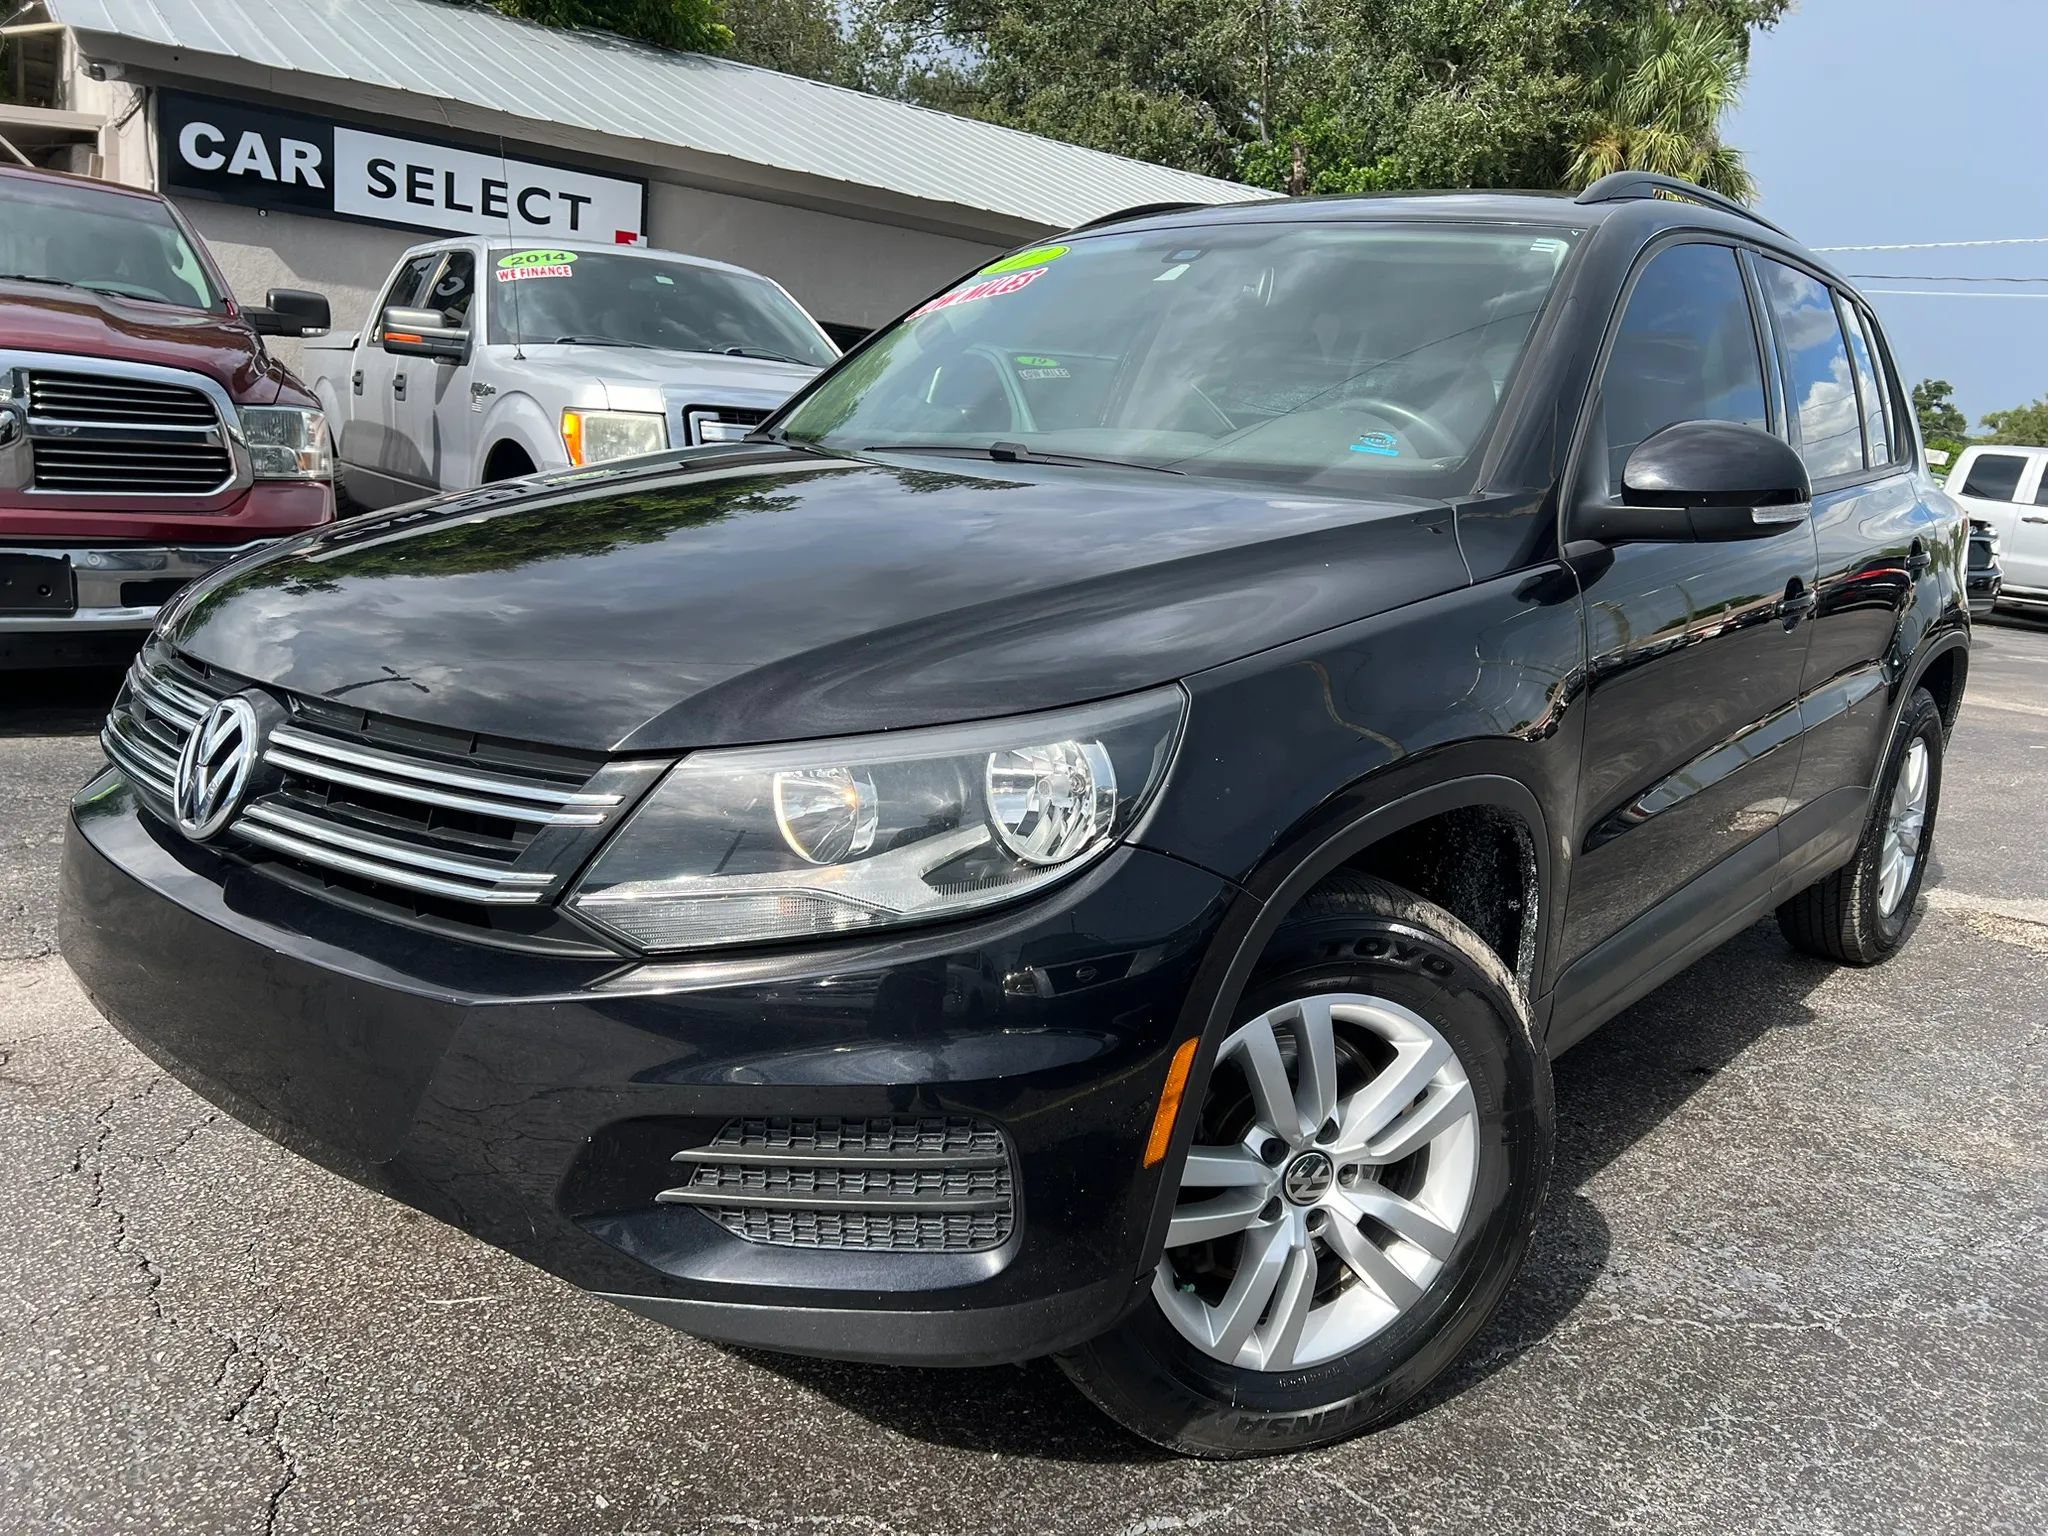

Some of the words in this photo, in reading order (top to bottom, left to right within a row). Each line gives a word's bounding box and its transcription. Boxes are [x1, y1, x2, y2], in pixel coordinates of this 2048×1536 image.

[178, 121, 326, 189] CAR
[366, 158, 592, 231] SELECT
[499, 269, 517, 281] WE
[520, 265, 571, 278] FINANCE
[511, 253, 567, 266] 2014
[1319, 937, 1456, 977] TOYO
